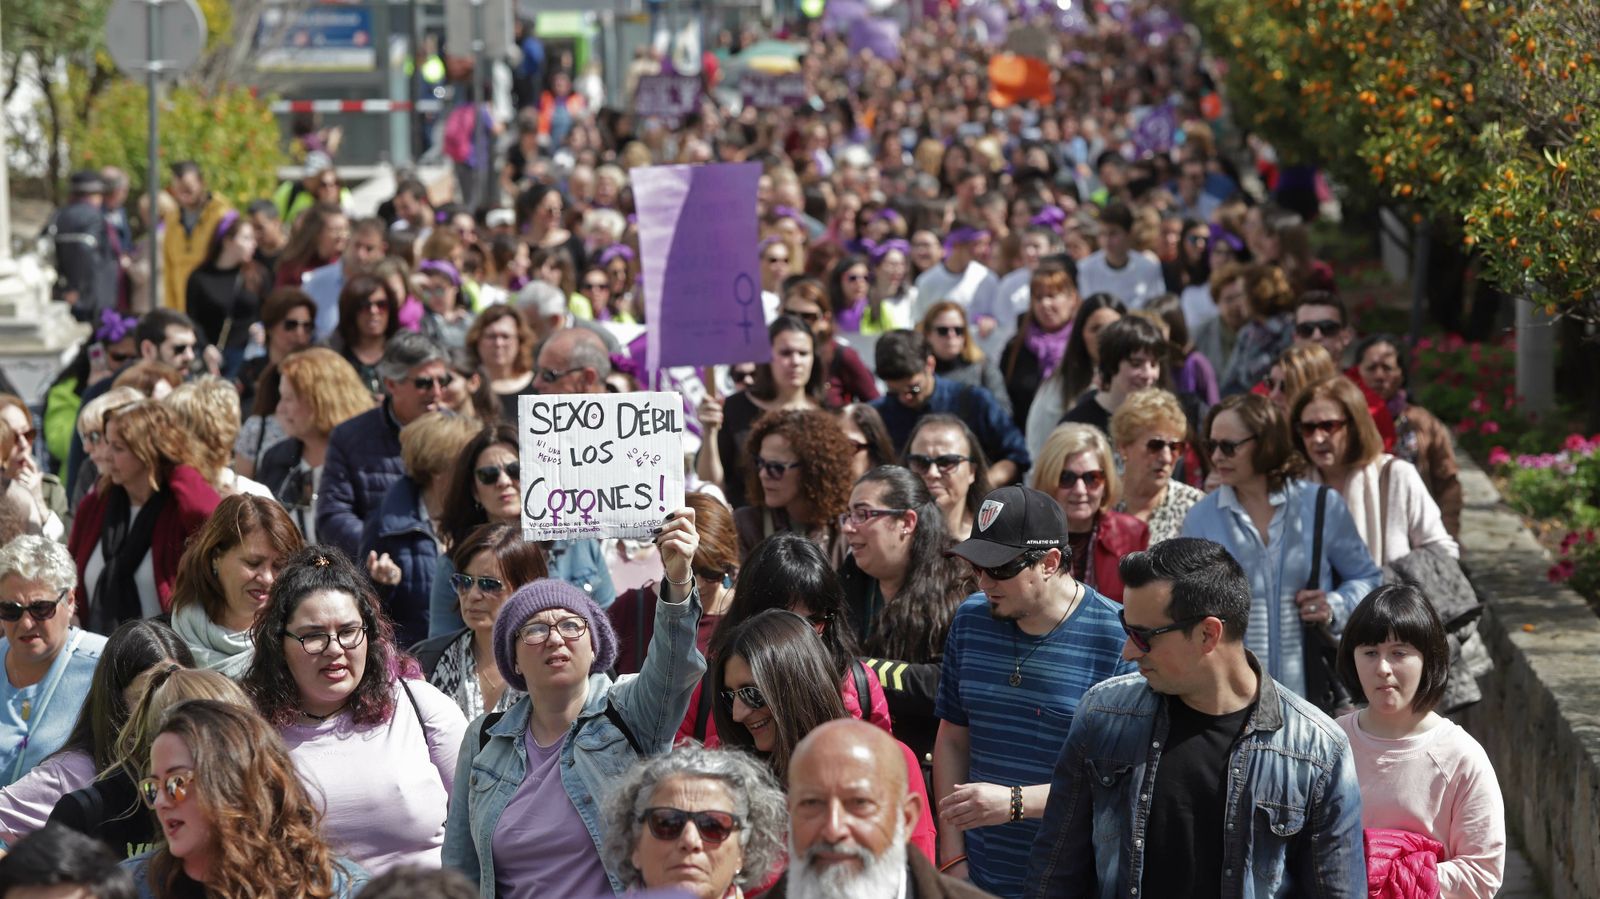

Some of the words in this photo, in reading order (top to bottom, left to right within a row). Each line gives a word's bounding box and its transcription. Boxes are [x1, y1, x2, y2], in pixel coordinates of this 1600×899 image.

[530, 400, 604, 434] SEXO
[617, 401, 682, 439] DÉBIL
[536, 440, 546, 448] NI
[570, 440, 614, 467] LOS
[626, 448, 638, 460] NO
[636, 451, 650, 468] ES
[650, 454, 661, 466] NO
